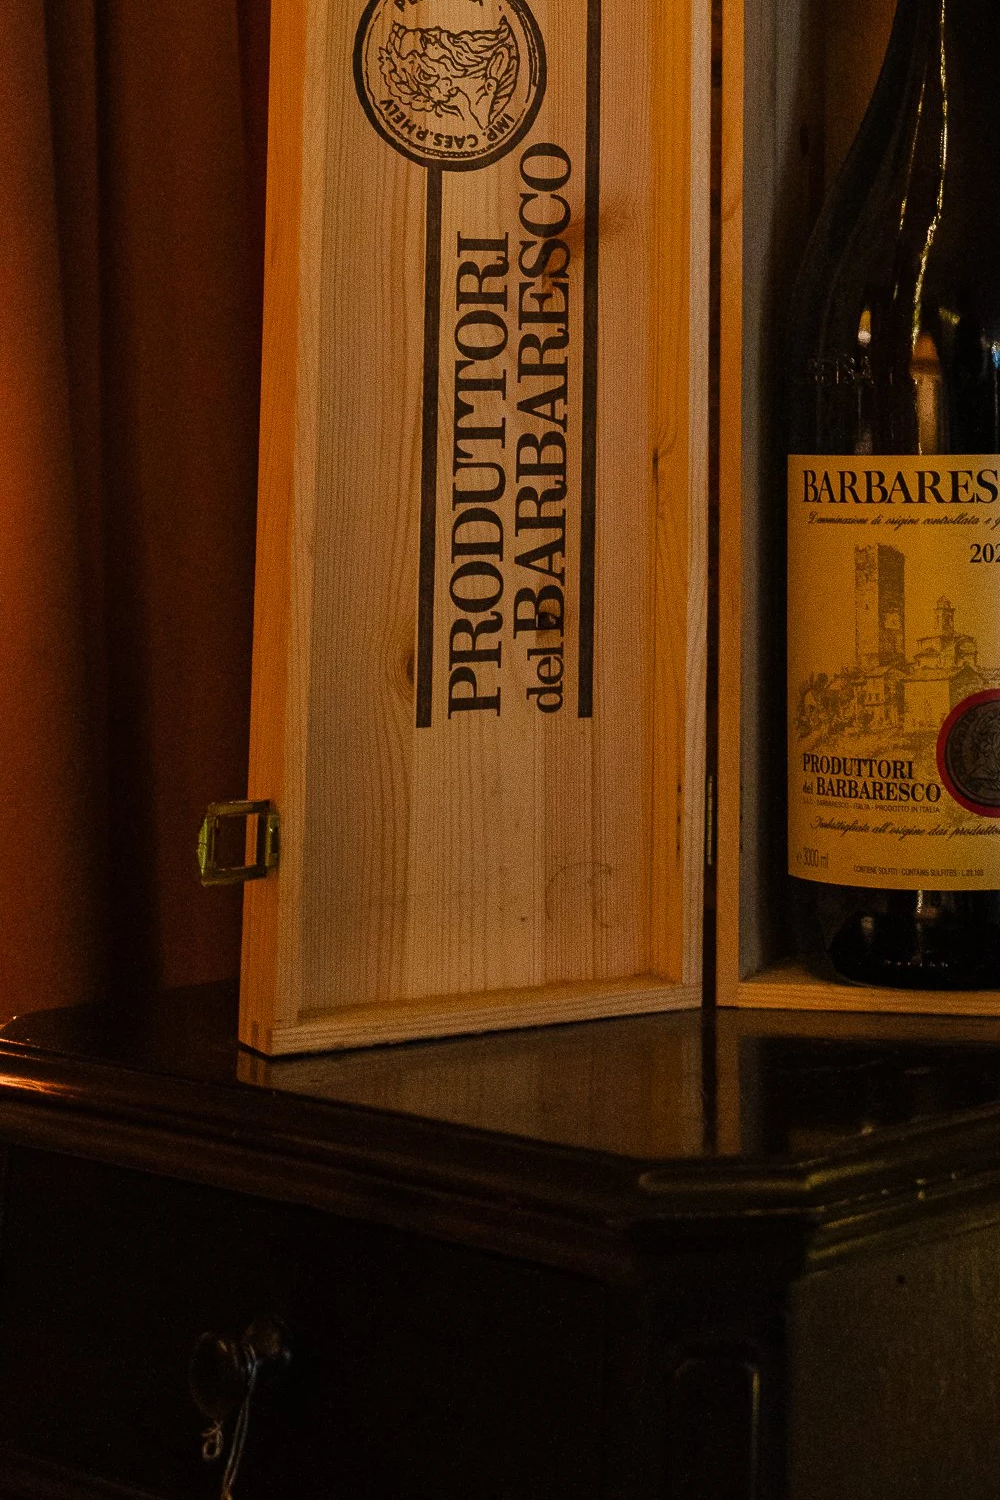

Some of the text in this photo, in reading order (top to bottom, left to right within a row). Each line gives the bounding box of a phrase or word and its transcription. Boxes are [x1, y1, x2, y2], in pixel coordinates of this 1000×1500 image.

[513, 142, 572, 714] del BARBARESCO
[448, 230, 510, 719] PRODUTTORI
[870, 513, 883, 525] di
[885, 514, 919, 531] origine
[923, 511, 980, 526] controllata
[803, 753, 914, 780] PRODUTTORI
[803, 782, 813, 795] del
[816, 776, 942, 803] BARBARESCO
[875, 804, 910, 813] PRODOTTO
[919, 806, 941, 814] ITALIA
[928, 825, 949, 836] dai
[803, 847, 819, 868] 3000
[820, 853, 829, 869] ml
[930, 868, 957, 877] SULFITES
